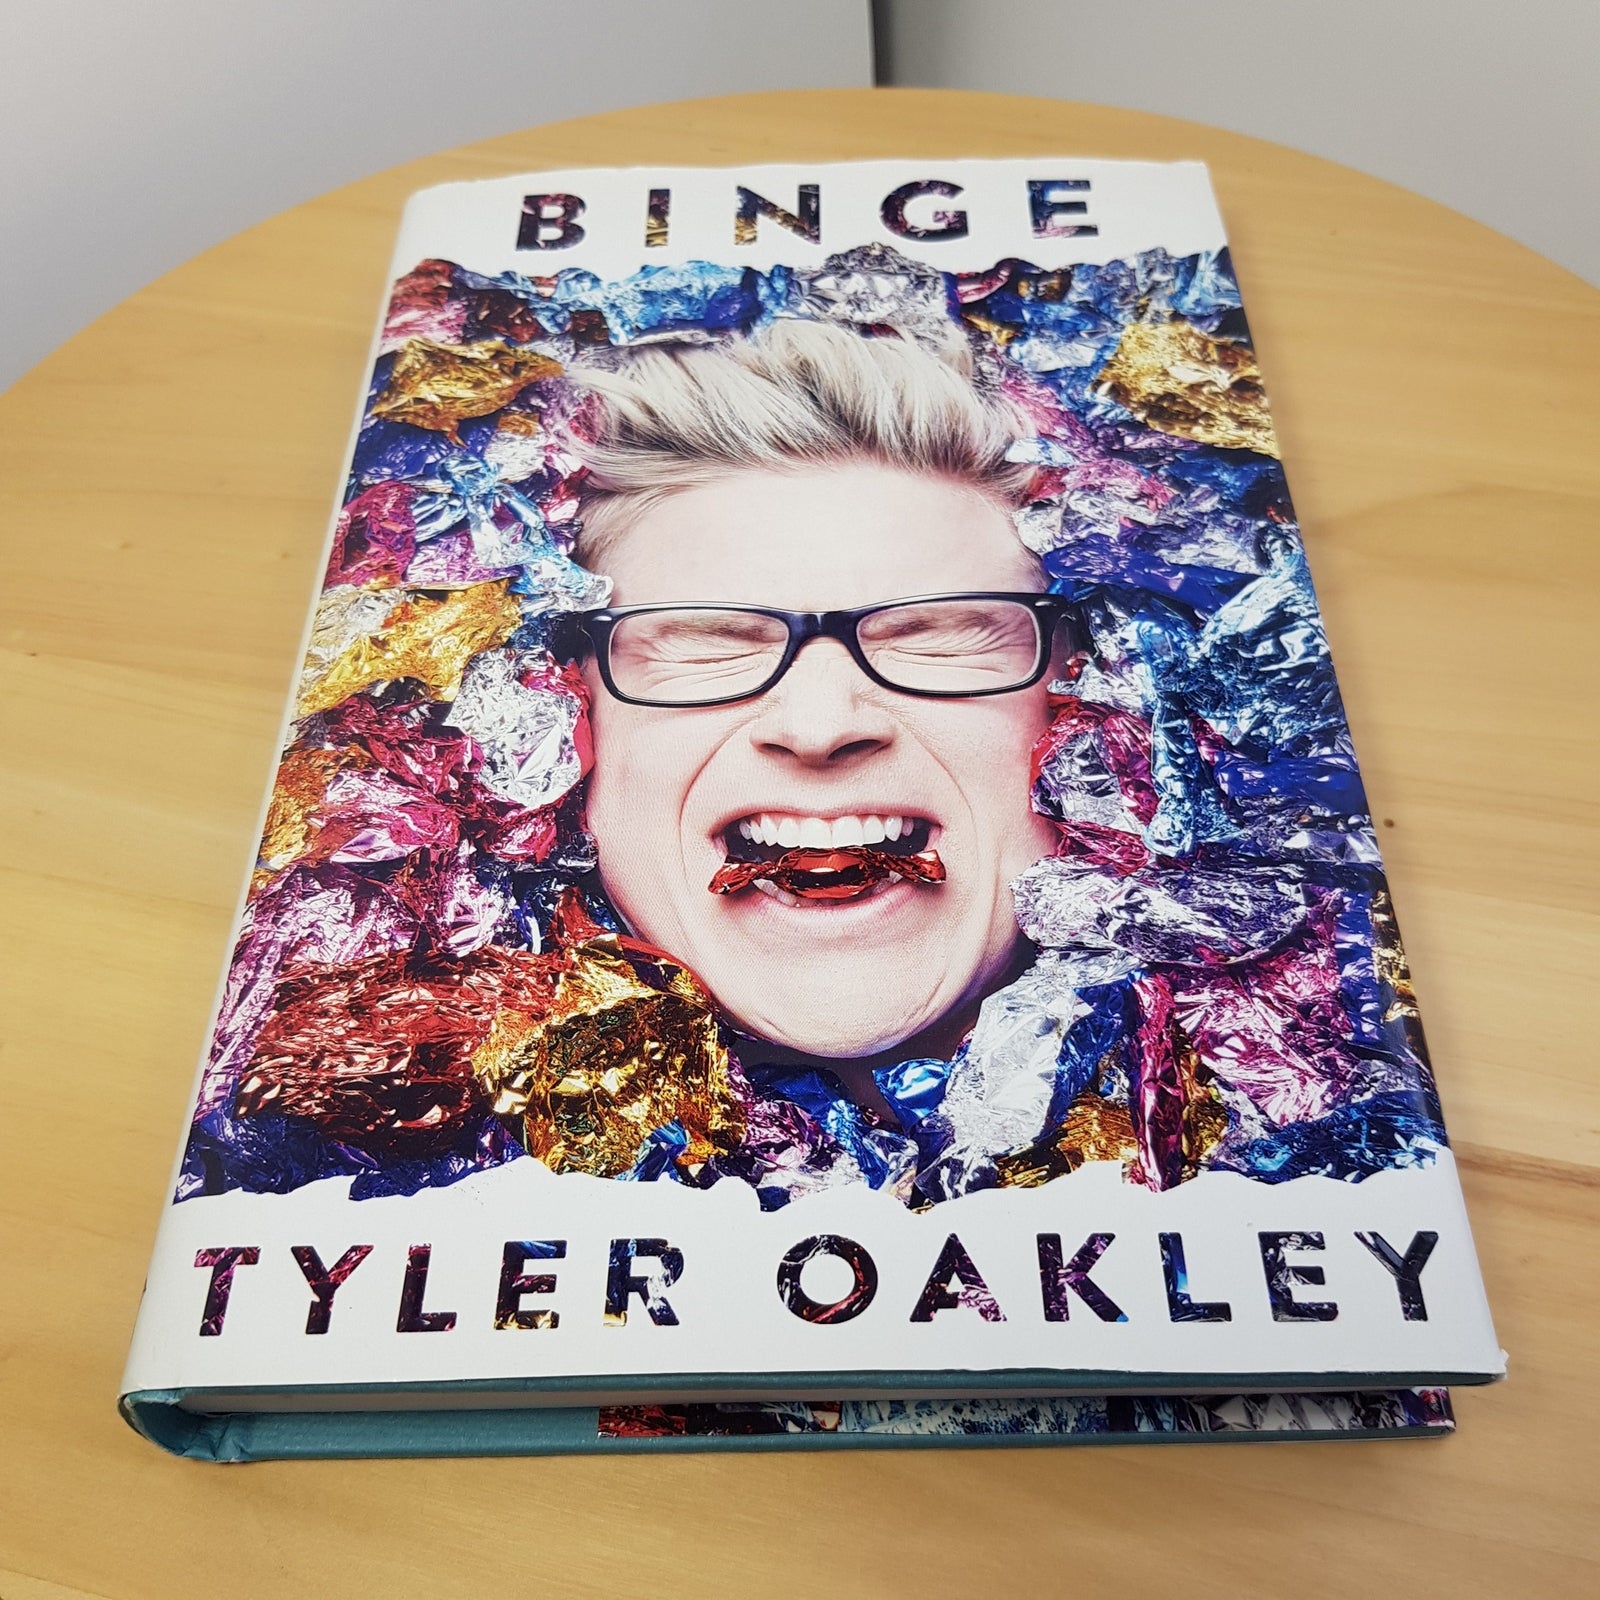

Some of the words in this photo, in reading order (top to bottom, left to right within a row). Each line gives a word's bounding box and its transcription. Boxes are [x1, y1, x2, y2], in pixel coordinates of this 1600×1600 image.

[515, 179, 1099, 251] BINGE
[194, 1237, 686, 1337] TYLER
[776, 1230, 1439, 1325] OAKLEY
